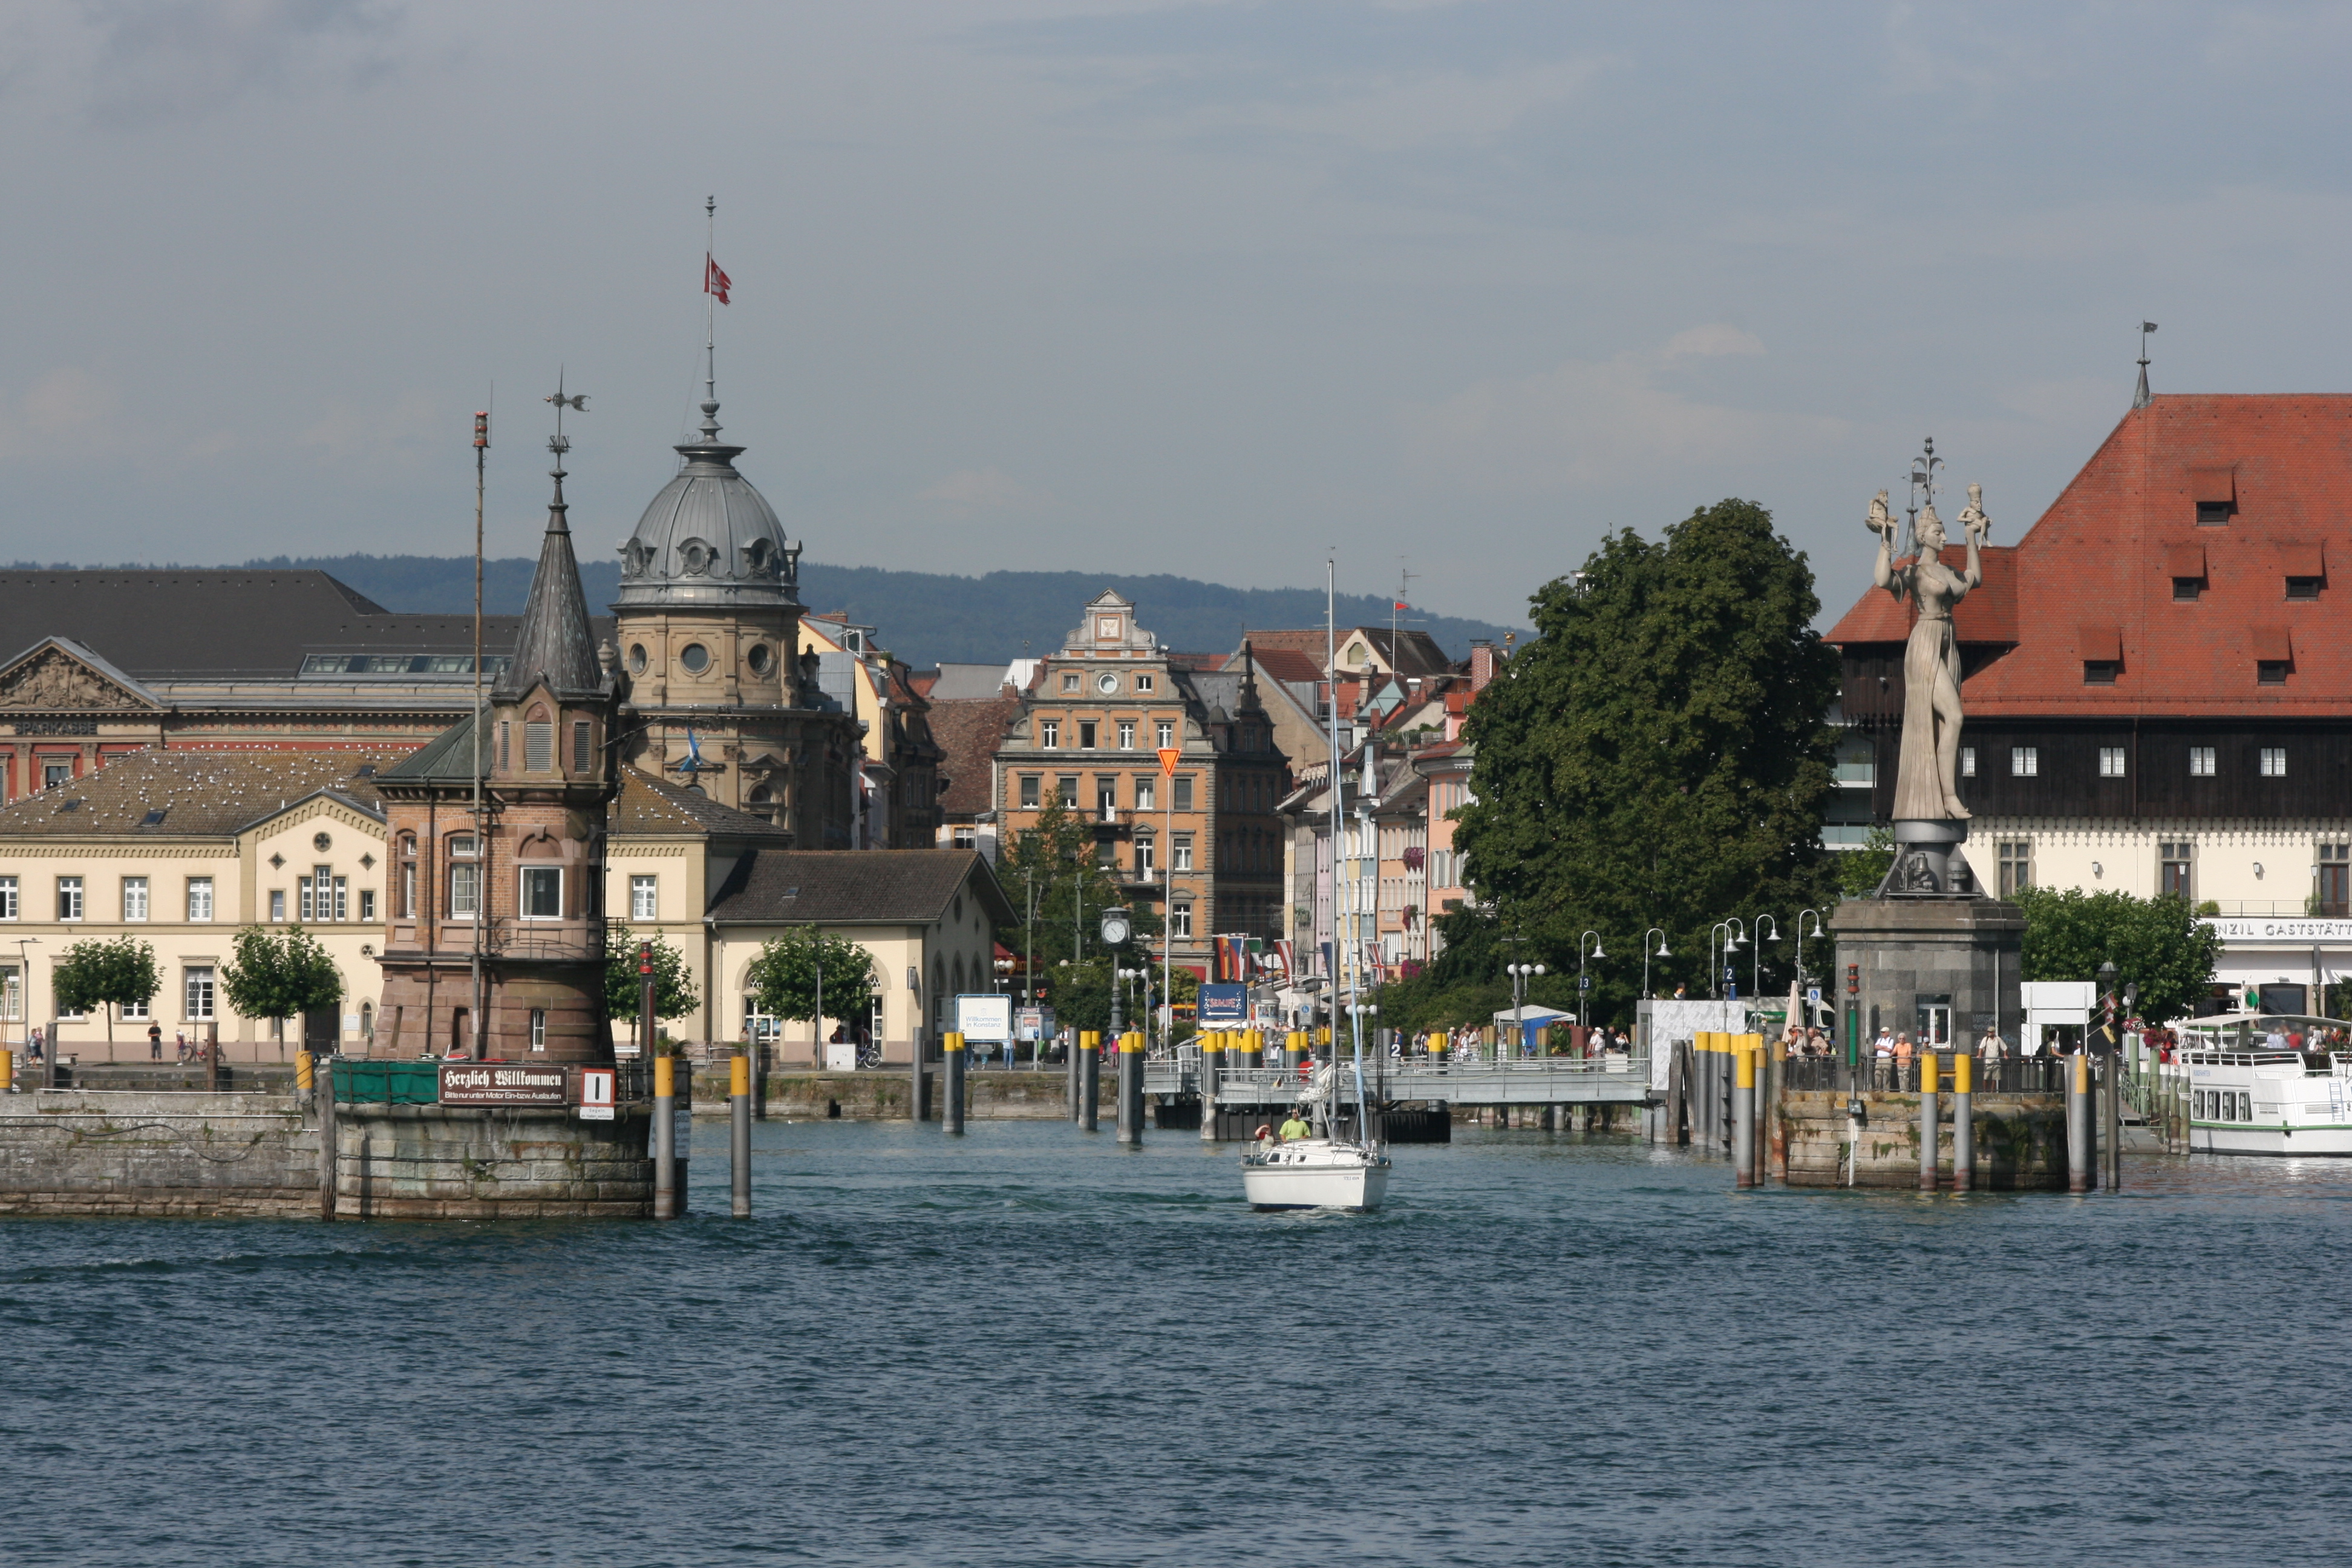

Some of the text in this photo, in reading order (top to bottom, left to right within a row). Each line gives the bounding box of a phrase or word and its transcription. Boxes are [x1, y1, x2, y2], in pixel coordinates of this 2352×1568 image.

[13, 721, 97, 734] SPARKASSE
[2216, 923, 2254, 935] NZIL
[1726, 968, 1733, 979] 2
[1391, 1044, 1400, 1057] 2
[445, 1070, 561, 1089] Herzlich Willkommen
